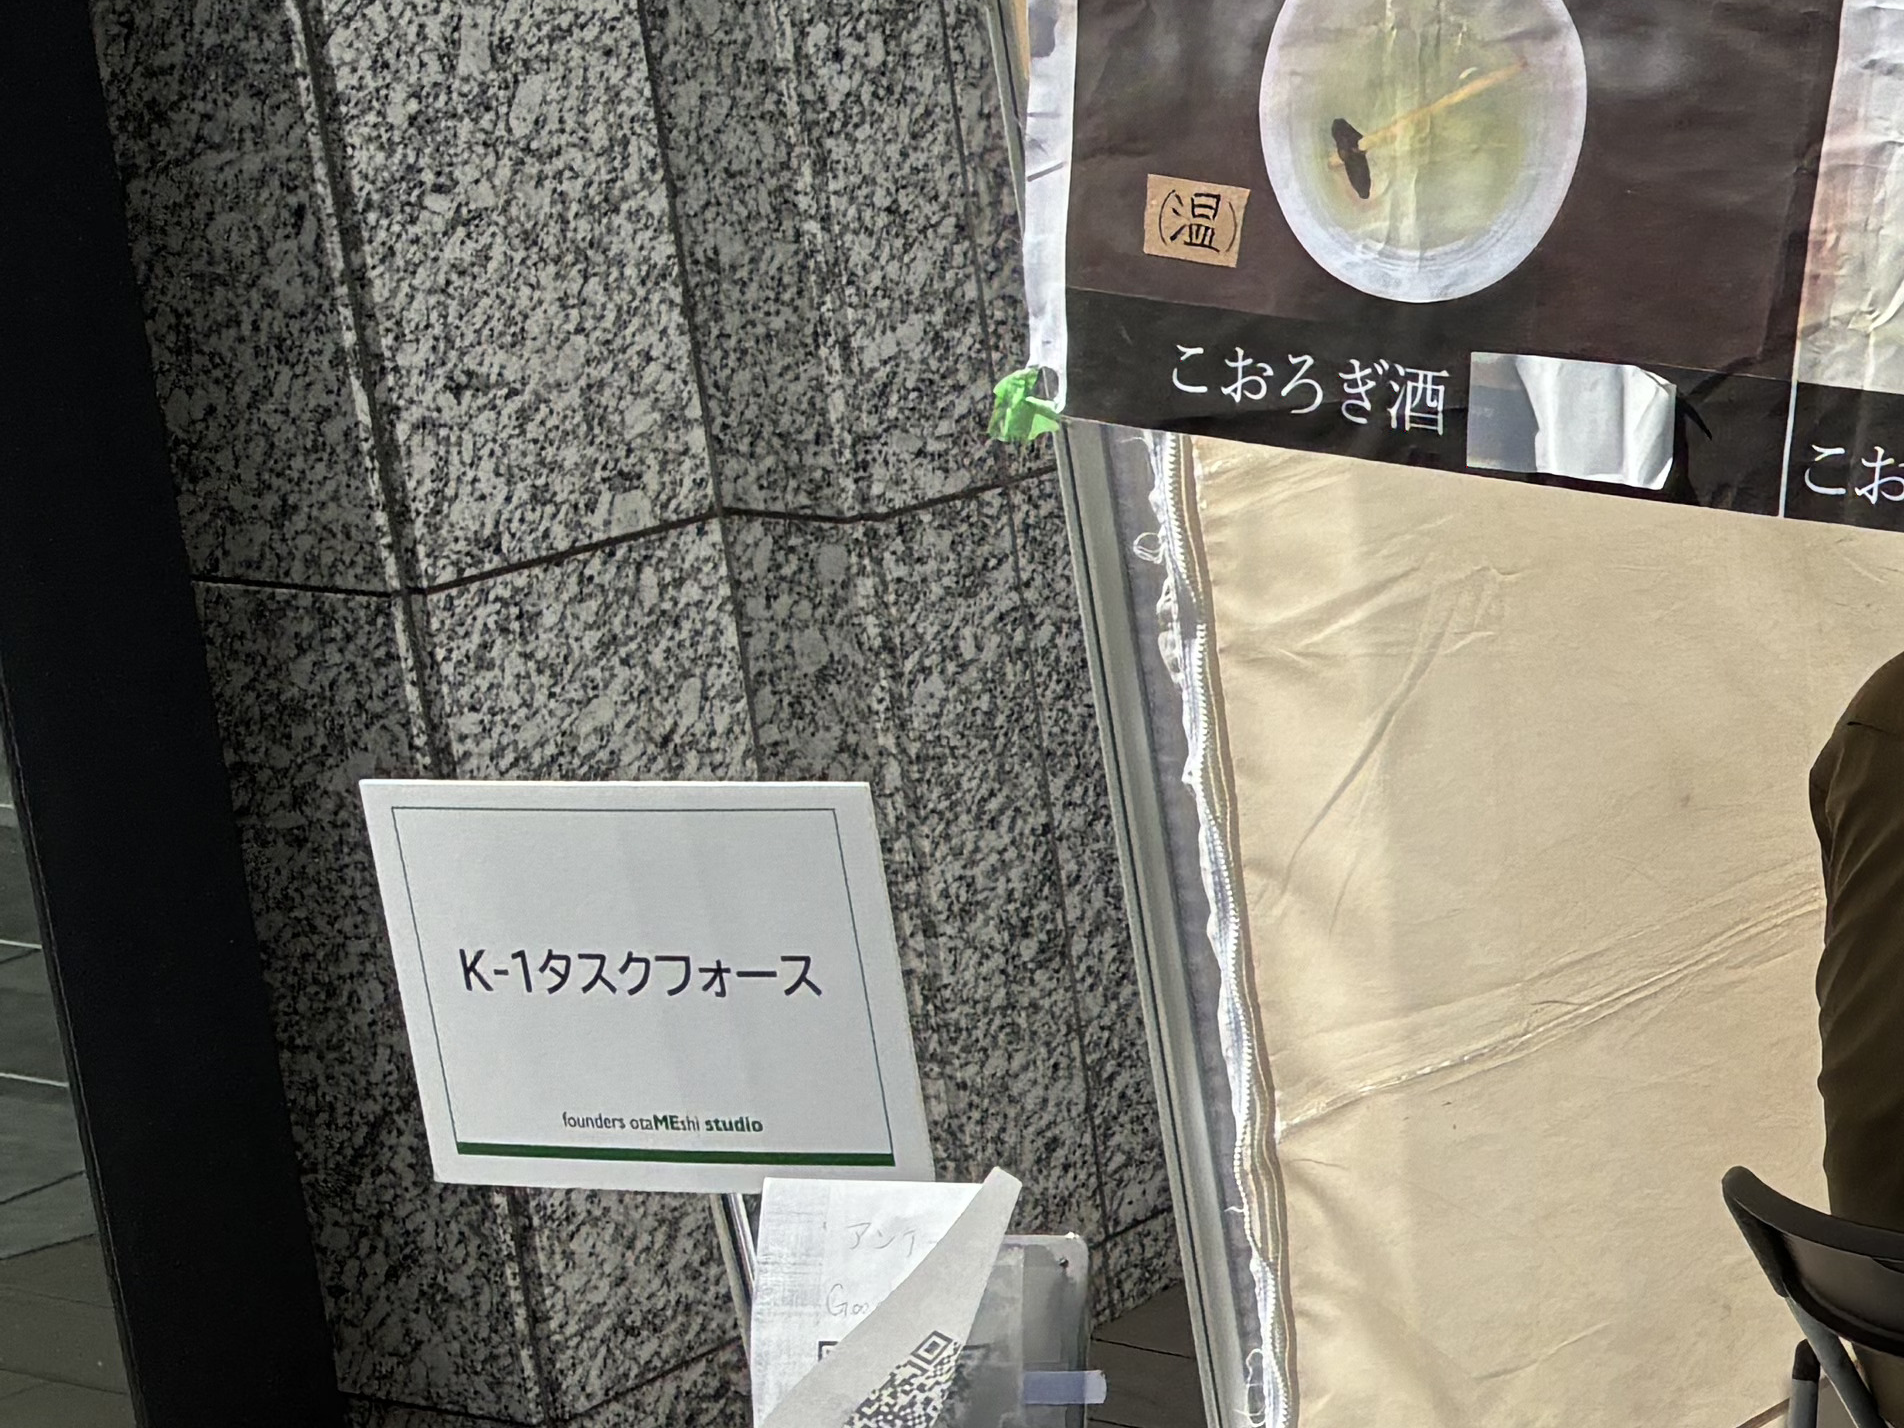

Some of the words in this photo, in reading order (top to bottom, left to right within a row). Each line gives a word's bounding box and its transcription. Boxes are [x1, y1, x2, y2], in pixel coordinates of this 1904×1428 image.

[1171, 344, 1448, 436] こおろぎ酒
[458, 947, 823, 998] K-1タスクフォース
[562, 1111, 626, 1130] founders
[704, 1116, 764, 1132] studio
